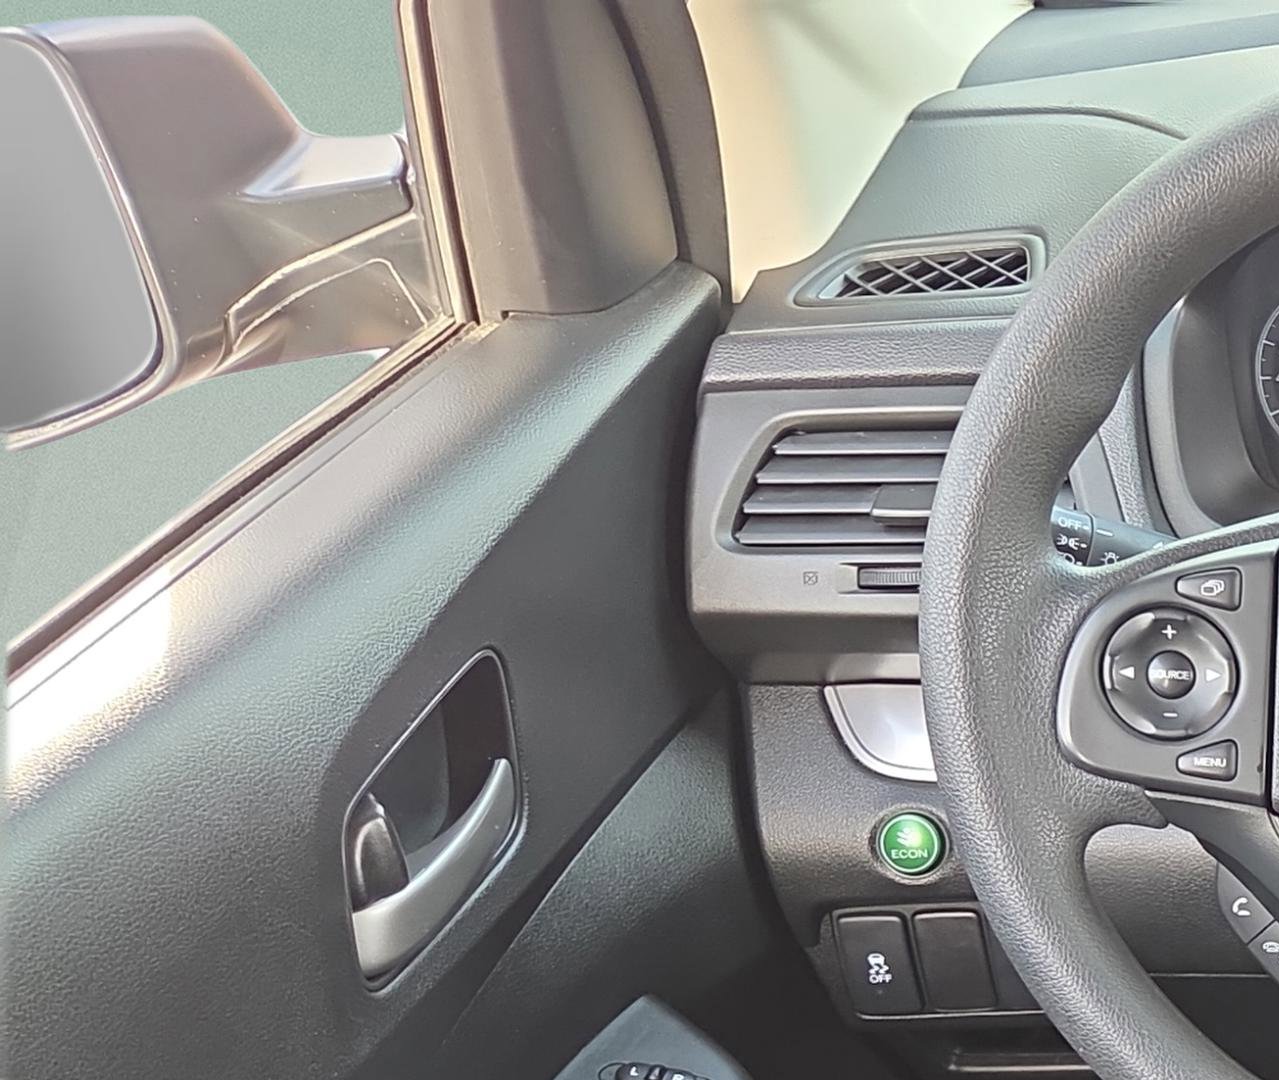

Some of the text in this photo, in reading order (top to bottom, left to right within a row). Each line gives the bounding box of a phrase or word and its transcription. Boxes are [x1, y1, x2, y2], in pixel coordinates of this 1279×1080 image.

[1058, 516, 1082, 530] OFF
[1193, 756, 1227, 768] MENU
[891, 849, 928, 859] ECON
[869, 974, 892, 984] OFF
[630, 1066, 639, 1076] L
